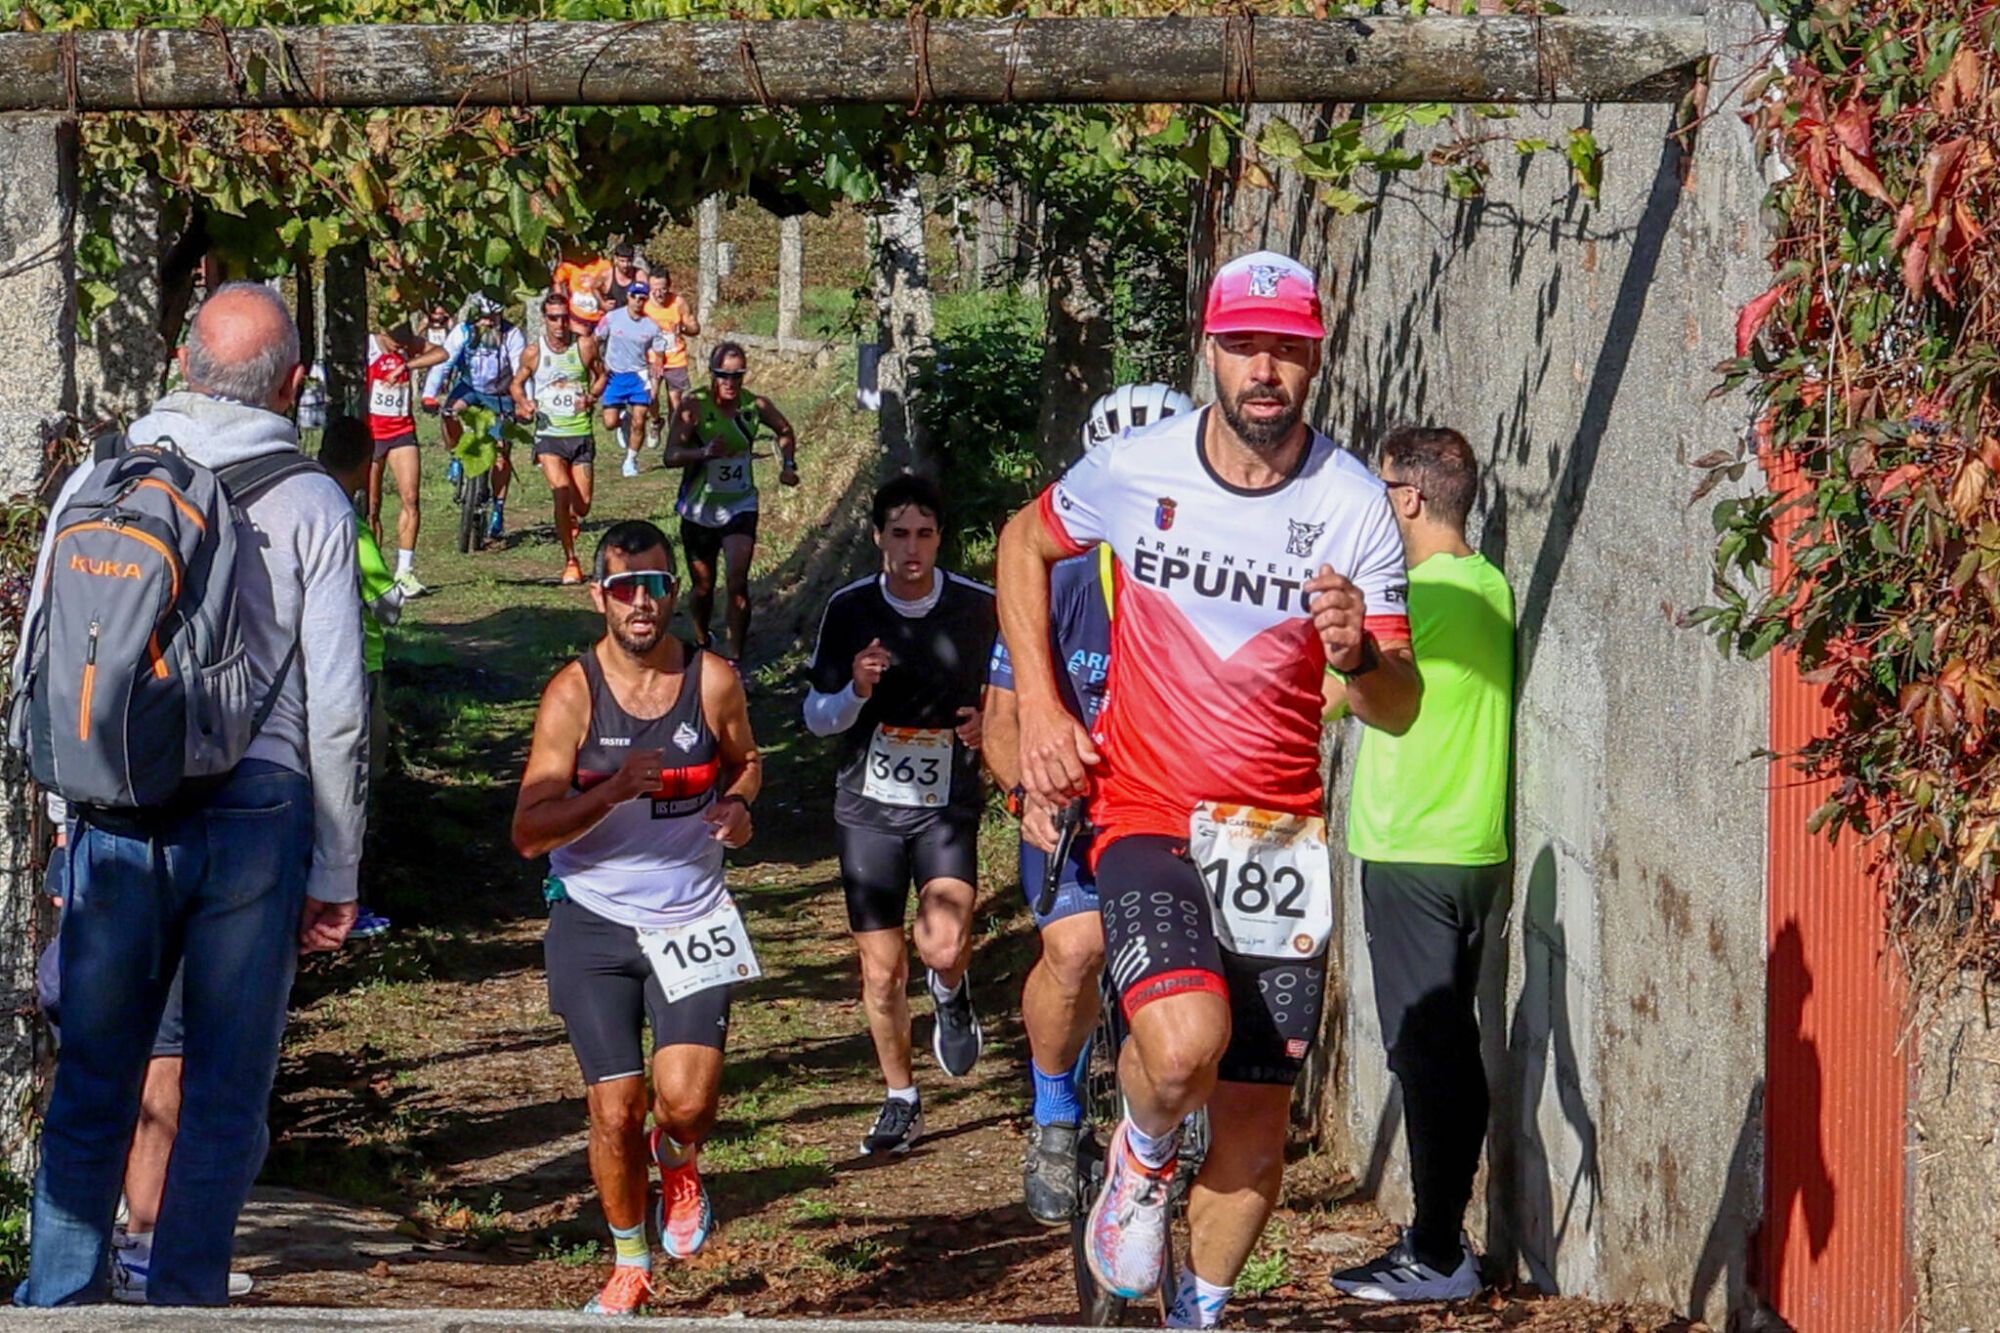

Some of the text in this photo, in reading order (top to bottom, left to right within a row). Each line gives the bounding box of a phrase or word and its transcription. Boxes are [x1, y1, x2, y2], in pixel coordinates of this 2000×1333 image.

[375, 392, 405, 408] 386
[552, 394, 573, 407] 68
[718, 465, 743, 481] 34
[69, 554, 142, 580] KUKA
[1136, 535, 1315, 579] ARMENTEIR
[872, 750, 940, 786] 363
[1202, 857, 1306, 919] 182
[661, 924, 737, 970] 165
